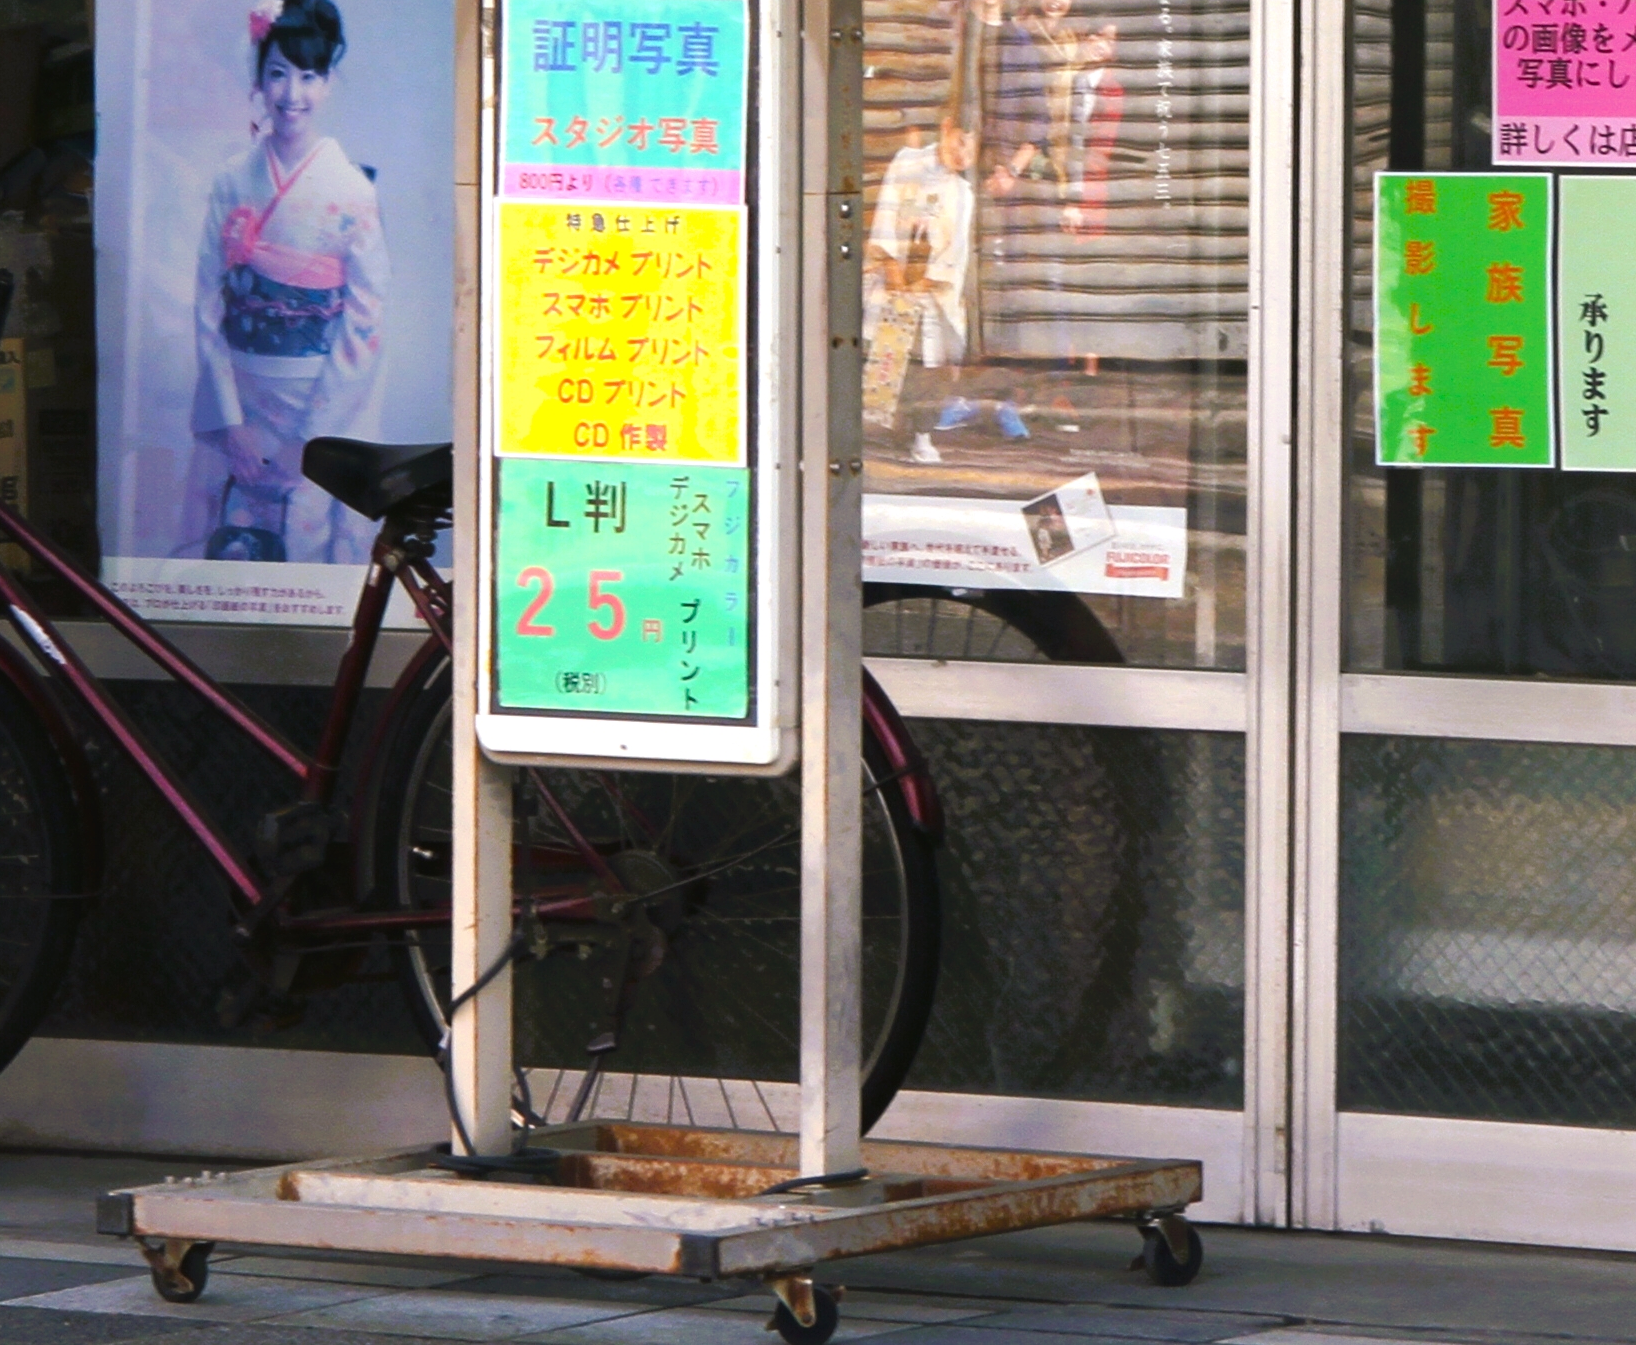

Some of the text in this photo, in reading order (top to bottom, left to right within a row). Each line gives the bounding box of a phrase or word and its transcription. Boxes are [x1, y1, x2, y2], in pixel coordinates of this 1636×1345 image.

[531, 18, 721, 78] 証明写真
[530, 113, 721, 156] スタジオ写真
[565, 212, 681, 235] 特急仕上げ
[533, 246, 713, 283] デジカメ プリント
[542, 291, 704, 324] スマホ プリント
[1403, 177, 1438, 458] 撮影します
[1485, 189, 1526, 451] 家族写真
[534, 334, 710, 368] フィルム プリント
[1577, 292, 1611, 439] 承ります
[557, 377, 687, 410] CD プリント
[572, 421, 669, 454] CD 作製
[545, 479, 629, 535] L判
[667, 474, 691, 583] デジカメ
[690, 492, 713, 572] スマホ
[678, 596, 704, 712] プリント
